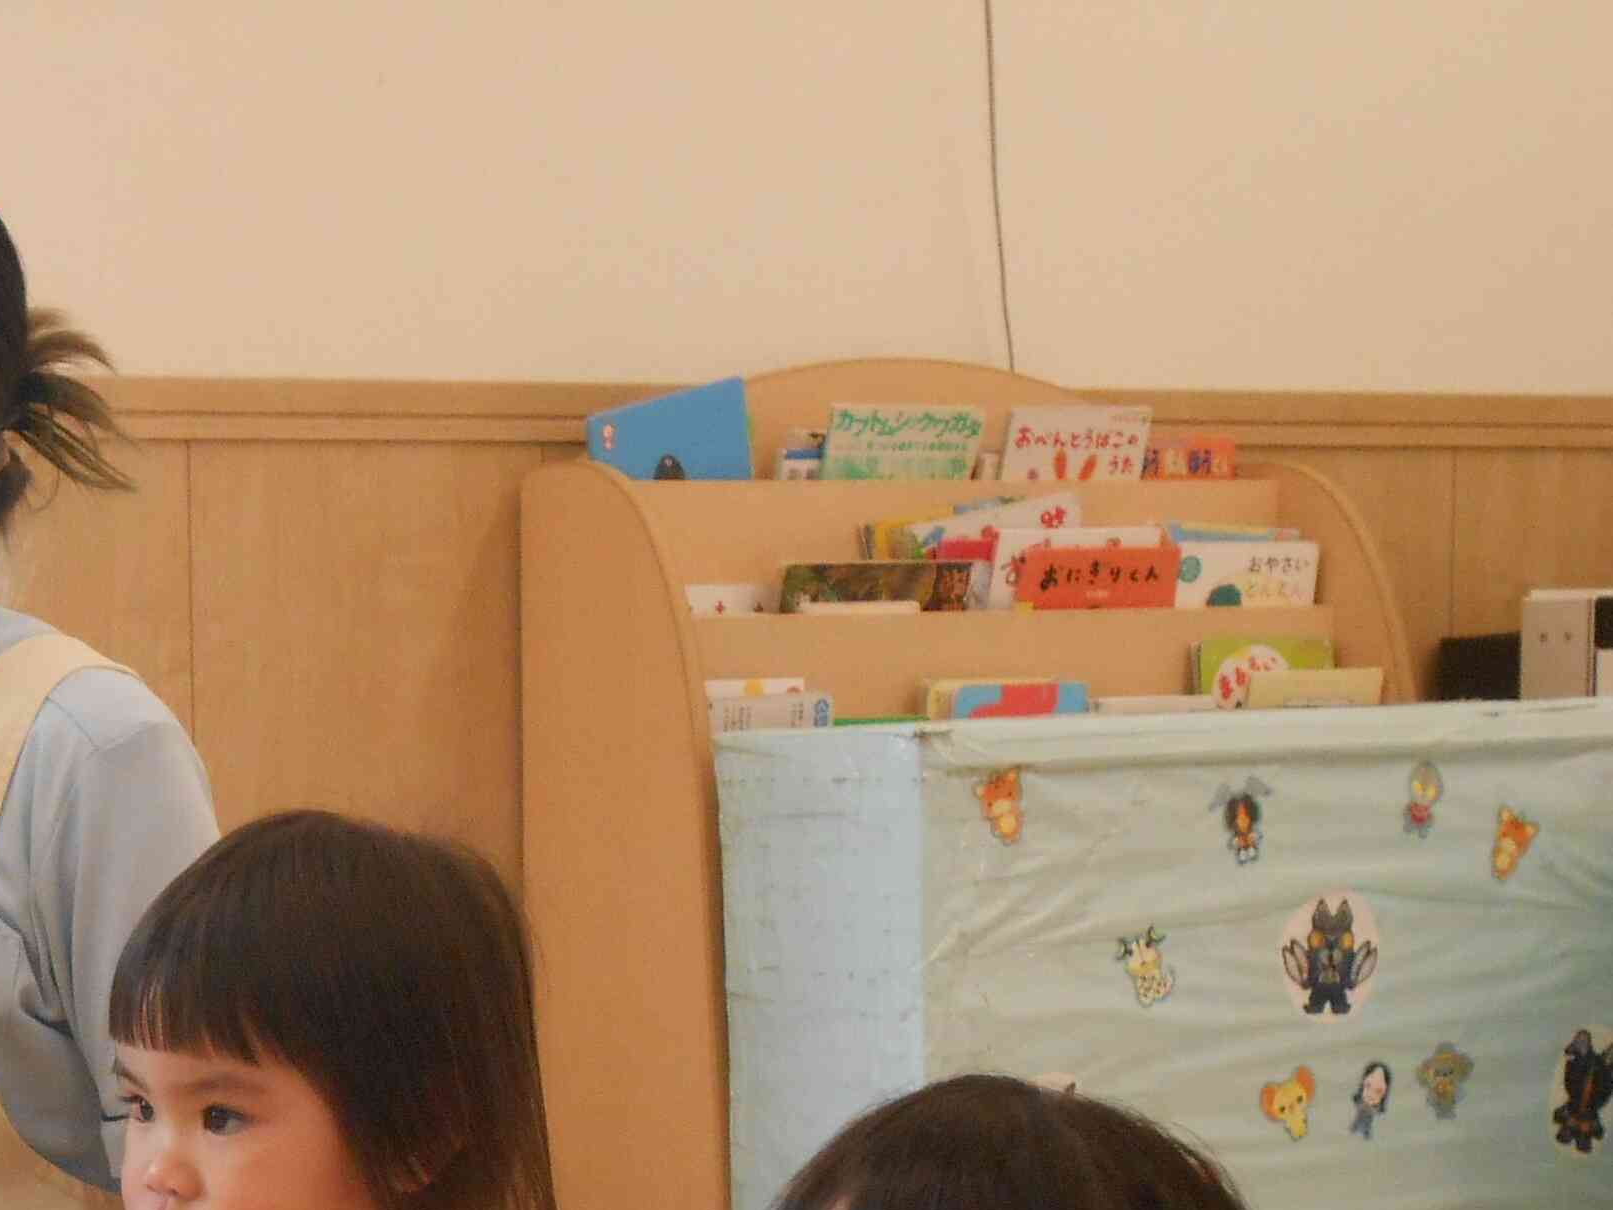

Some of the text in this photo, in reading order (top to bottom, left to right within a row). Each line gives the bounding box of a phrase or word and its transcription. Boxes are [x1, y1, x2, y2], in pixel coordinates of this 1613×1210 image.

[1040, 560, 1159, 590] おにぎりくん
[1248, 555, 1310, 574] おやさい
